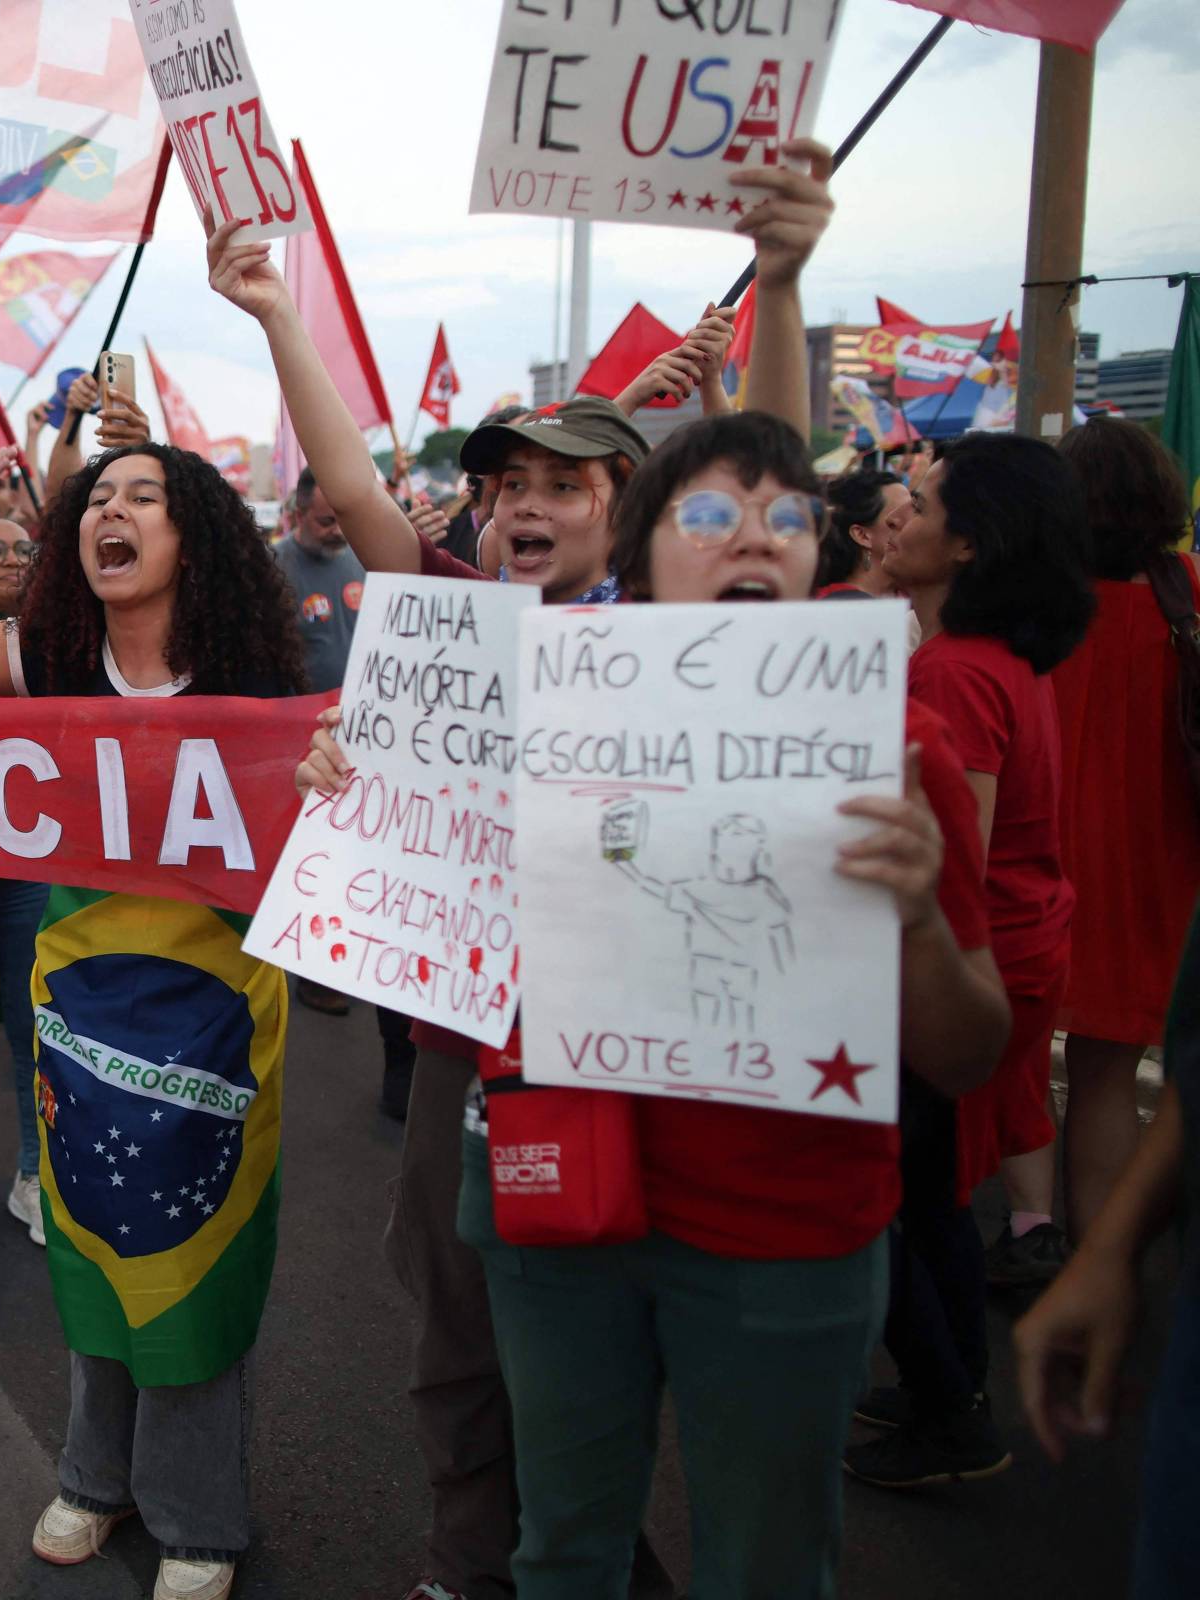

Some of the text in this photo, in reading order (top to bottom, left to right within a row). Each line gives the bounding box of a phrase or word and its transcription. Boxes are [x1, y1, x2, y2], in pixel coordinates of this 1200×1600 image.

[505, 46, 590, 153] TE
[227, 97, 297, 225] 13
[489, 167, 655, 213] VOTE 13
[382, 590, 480, 645] MINHA
[358, 647, 505, 717] MEMÓRIA
[533, 619, 889, 697] NÃO É UMA
[333, 698, 396, 751] NÃO
[411, 706, 435, 765] É
[521, 726, 897, 784] ESCOLHA DIFÍCIL
[294, 850, 513, 953] E EXALTANDO
[272, 911, 509, 1028] A TORTURA
[104, 1056, 251, 1115] PROGRESSO
[558, 1030, 776, 1080] VOTE 13
